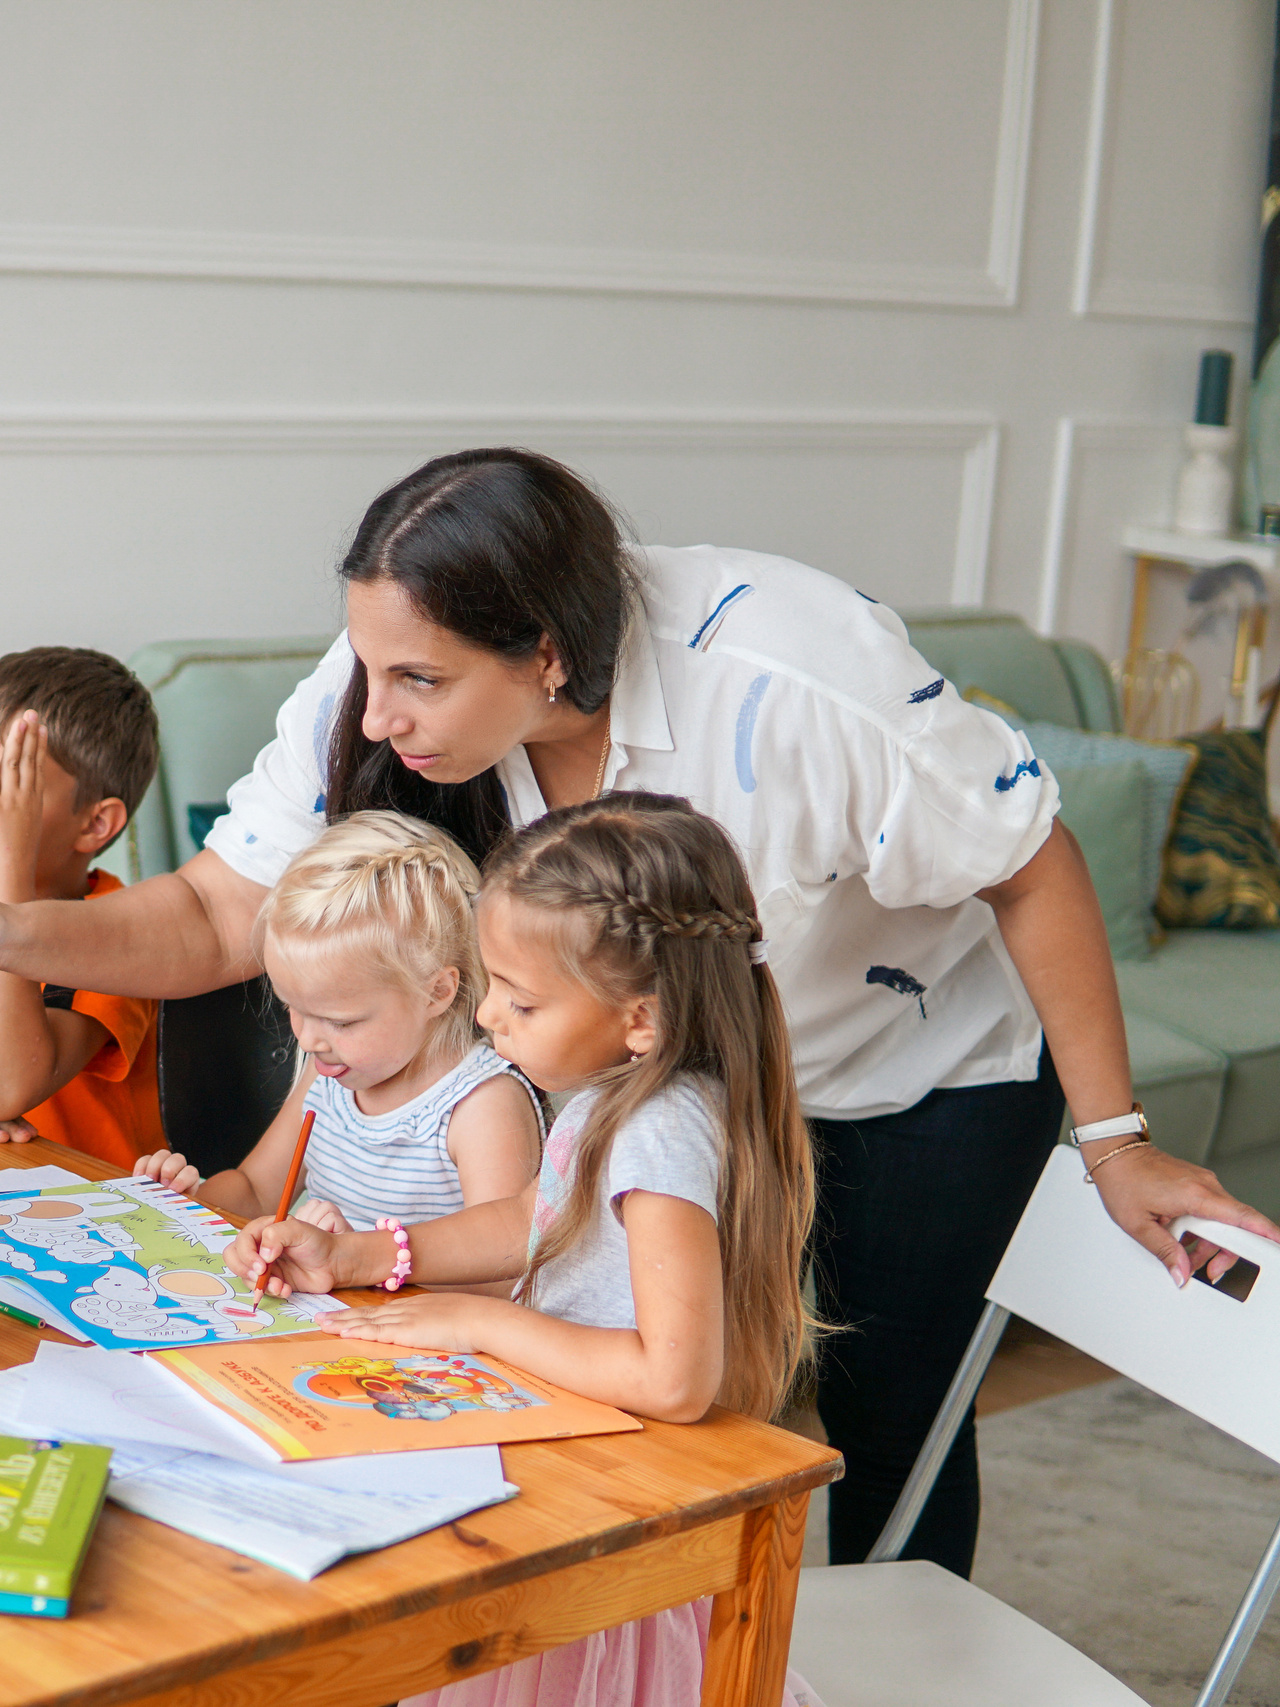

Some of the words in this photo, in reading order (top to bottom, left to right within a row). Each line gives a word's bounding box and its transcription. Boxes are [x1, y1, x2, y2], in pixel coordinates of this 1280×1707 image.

[221, 1361, 264, 1385] АЗБУКЕ
[266, 1394, 314, 1419] ДОРОГЕ
[305, 1420, 327, 1431] ПО
